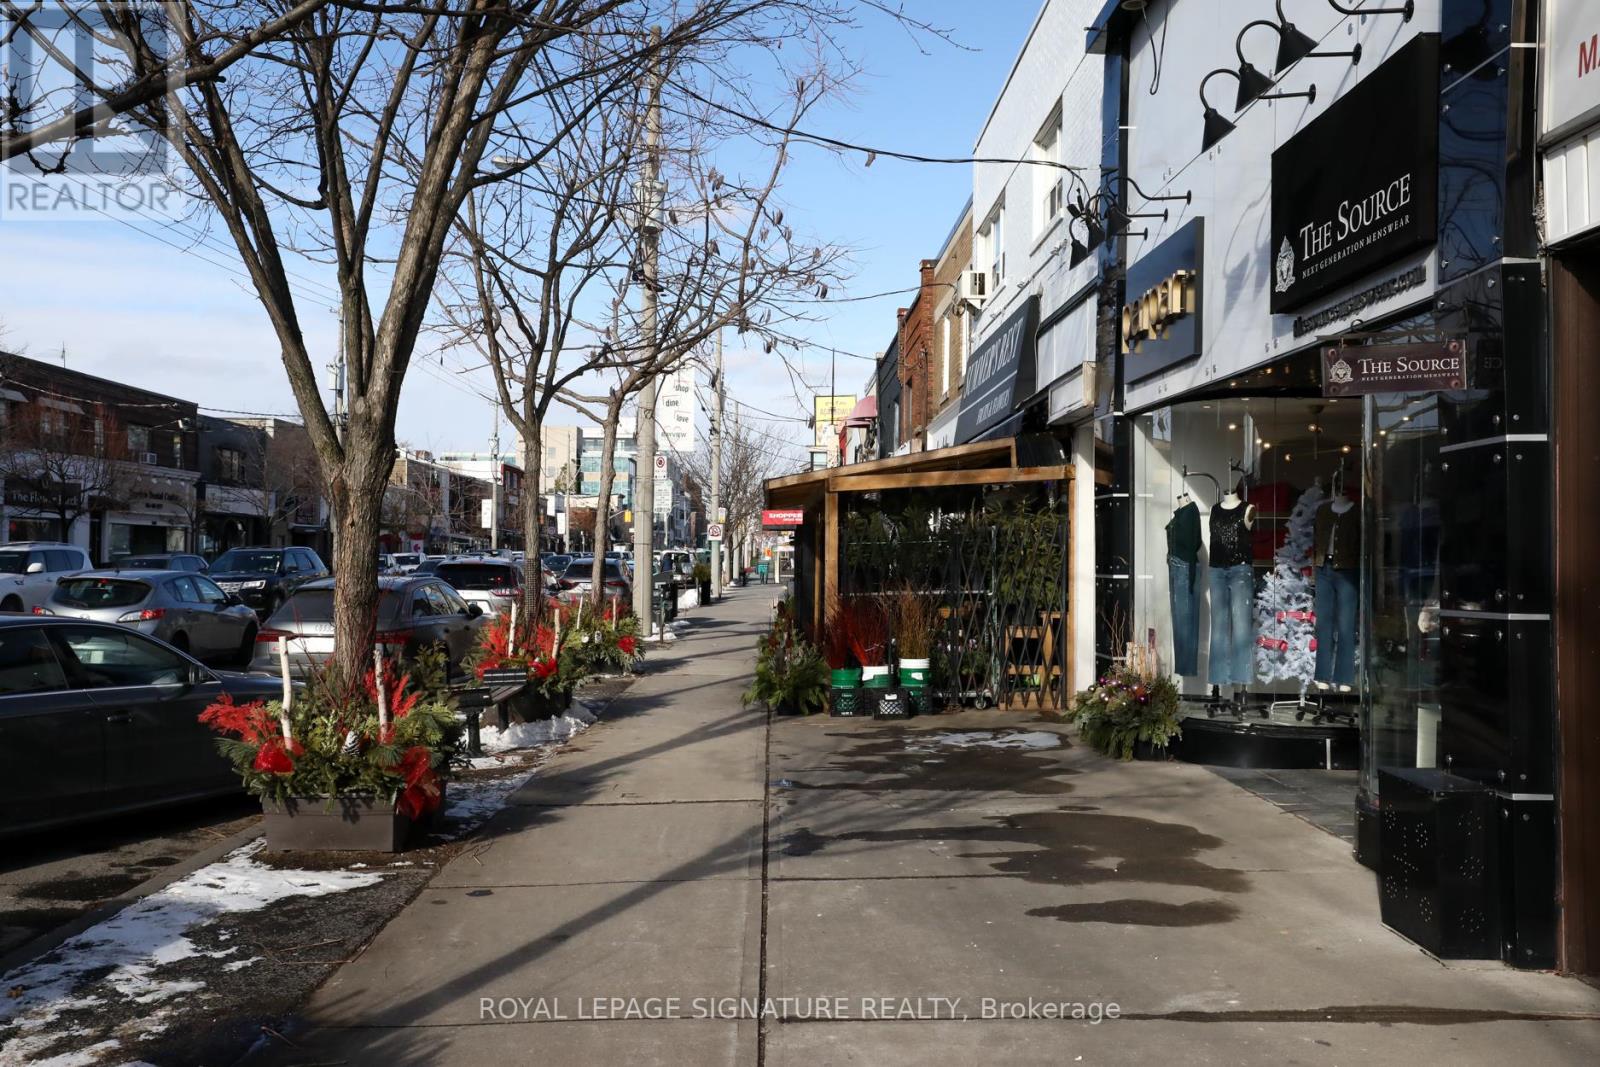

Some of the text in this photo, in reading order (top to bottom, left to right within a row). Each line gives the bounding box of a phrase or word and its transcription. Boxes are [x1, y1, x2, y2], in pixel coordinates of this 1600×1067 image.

[1578, 33, 1600, 78] M
[1300, 173, 1411, 261] THE SOURCE
[1302, 214, 1410, 279] NEXT GENERATION MENSWEAR
[1357, 356, 1460, 374] THE SOURCE
[675, 385, 690, 393] shop
[676, 414, 689, 423] love
